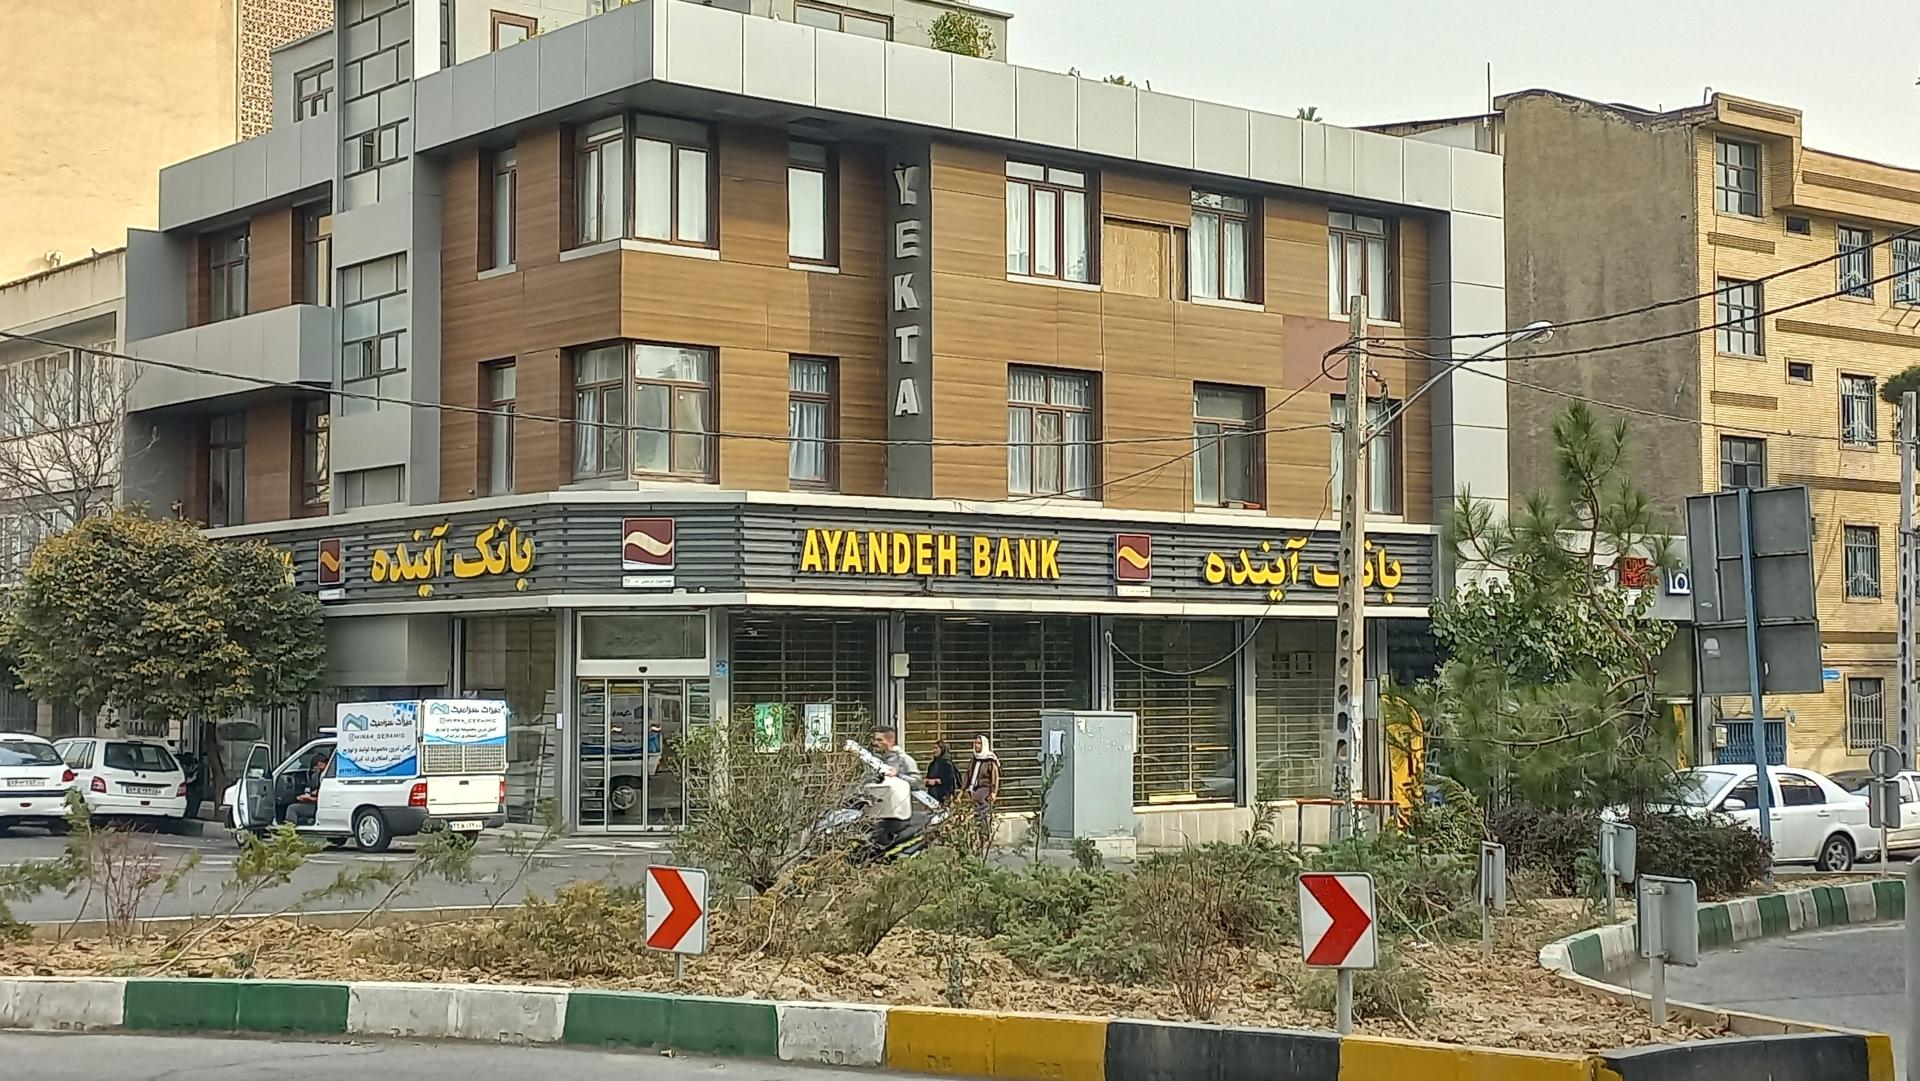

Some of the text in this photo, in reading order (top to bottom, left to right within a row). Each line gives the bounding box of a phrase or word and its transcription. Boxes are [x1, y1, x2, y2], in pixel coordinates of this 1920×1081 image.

[893, 163, 921, 416] YEKTA
[370, 522, 449, 597] آینده
[453, 517, 536, 592] بانک
[799, 528, 1061, 580] AYANDEH BANK
[1203, 536, 1309, 602] آینده
